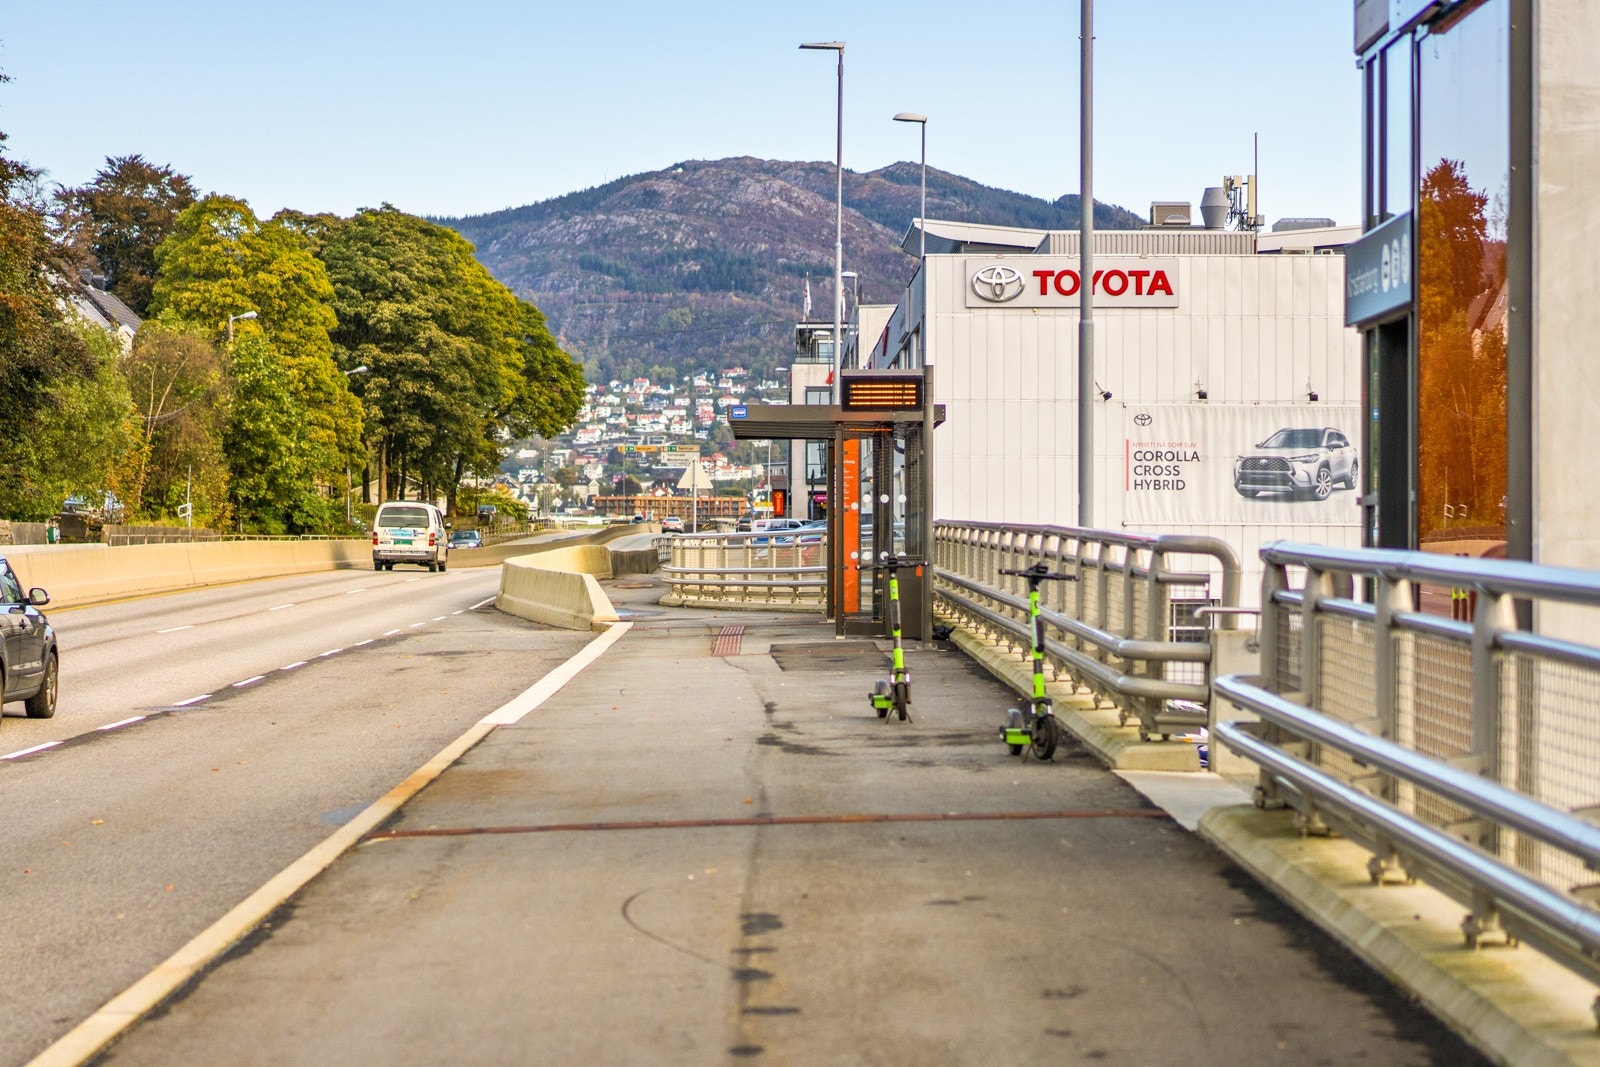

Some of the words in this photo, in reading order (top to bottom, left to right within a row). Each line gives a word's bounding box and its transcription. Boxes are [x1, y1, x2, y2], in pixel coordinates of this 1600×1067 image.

[1133, 450, 1200, 462] COROLLA
[1133, 465, 1181, 477] CROSS
[1134, 479, 1186, 491] HYBRID
